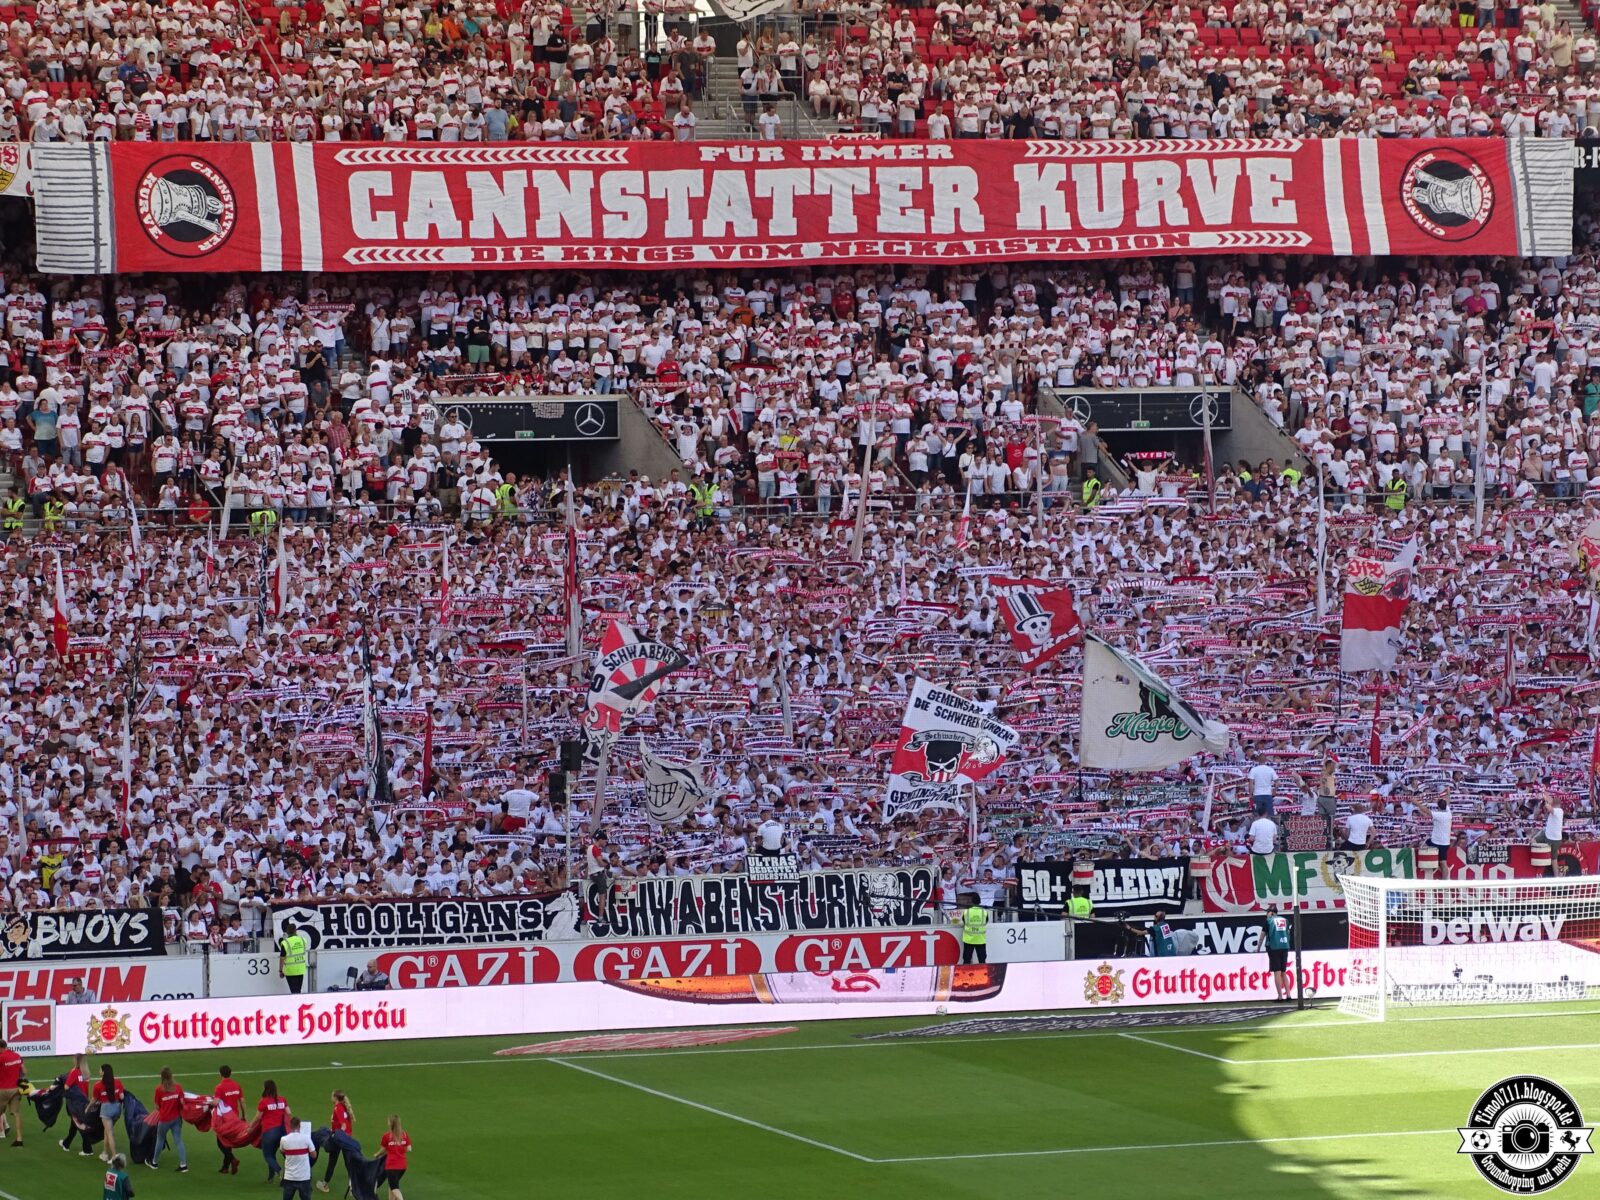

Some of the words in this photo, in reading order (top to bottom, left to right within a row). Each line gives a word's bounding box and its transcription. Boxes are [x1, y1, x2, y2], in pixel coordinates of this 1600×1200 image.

[699, 144, 785, 162] FÜR
[801, 144, 954, 161] IMMER
[140, 172, 164, 240] KURVE
[191, 161, 235, 251] CANNSTATTER
[348, 165, 985, 240] CANNSTATTER
[1013, 157, 1298, 230] KURVE
[1403, 153, 1446, 236] CANNSTATTER
[1469, 163, 1493, 225] KURVE
[471, 247, 545, 262] DIE
[561, 246, 695, 262] KINGS
[709, 244, 803, 260] VOM
[820, 233, 1191, 258] NECKARSTADION
[914, 697, 931, 711] DIE
[1106, 712, 1174, 743] Magic
[603, 806, 638, 814] ANNSTATT
[747, 855, 797, 867] ULTRAS
[749, 865, 798, 873] BEDEUTET
[750, 872, 800, 881] WIDERSTAND
[1252, 853, 1318, 899] MF
[1364, 848, 1414, 880] 91
[1021, 868, 1075, 900] 50+
[1090, 866, 1185, 900] BLEIBT!
[319, 901, 543, 936] HOOLIGANS
[588, 873, 870, 936] SCHWABENSTURM
[899, 871, 933, 928] 02
[36, 912, 149, 946] BWOYS
[1006, 929, 1028, 944] 34
[1421, 908, 1567, 945] betway
[247, 958, 270, 976] 33
[1132, 963, 1272, 1001] Stuttgarter
[139, 1009, 291, 1046] Stuttgarter
[298, 1001, 407, 1039] Hofbräu
